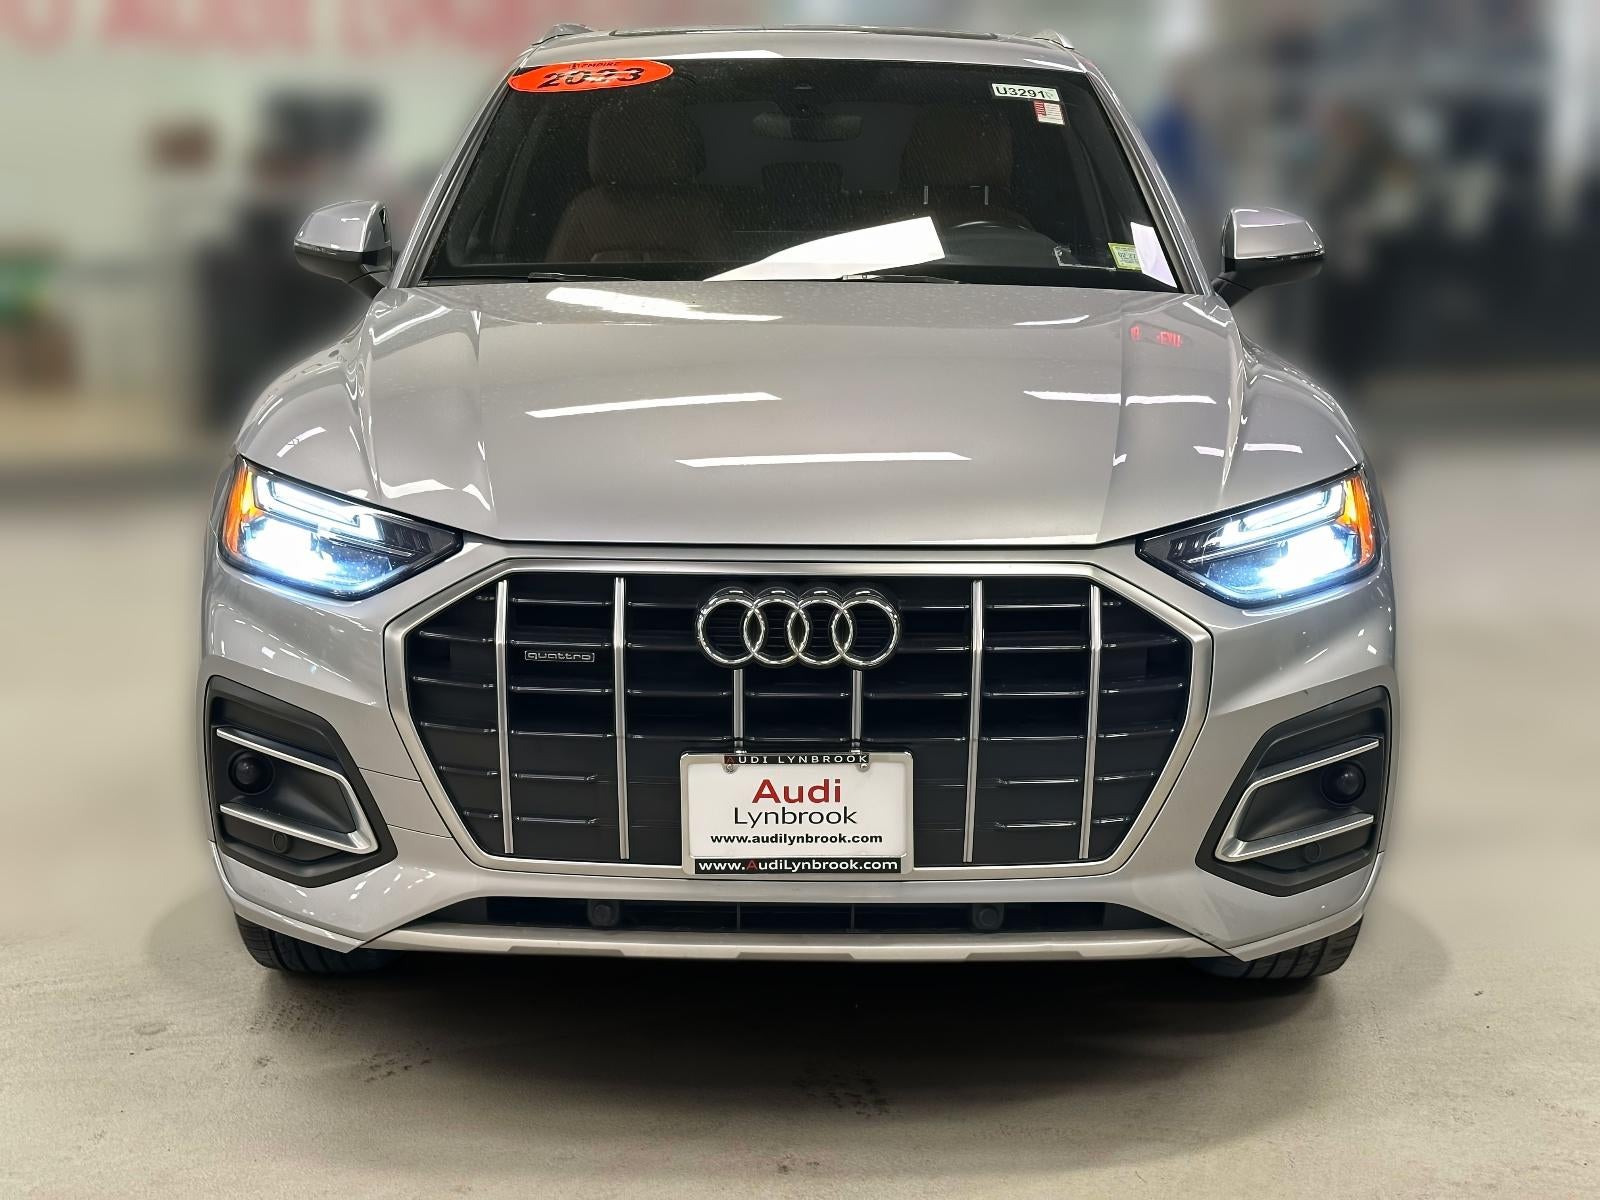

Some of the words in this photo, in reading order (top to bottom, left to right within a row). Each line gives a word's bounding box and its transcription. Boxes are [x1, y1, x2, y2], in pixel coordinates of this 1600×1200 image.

[526, 651, 592, 661] quattro
[725, 755, 769, 764] AUDI
[777, 755, 868, 764] LYNBROOK
[751, 778, 841, 804] Audi
[733, 806, 858, 829] Lynbrook
[710, 833, 883, 846] www.audilynbrook.com
[698, 858, 898, 873] www.AudiLynbrook.com
